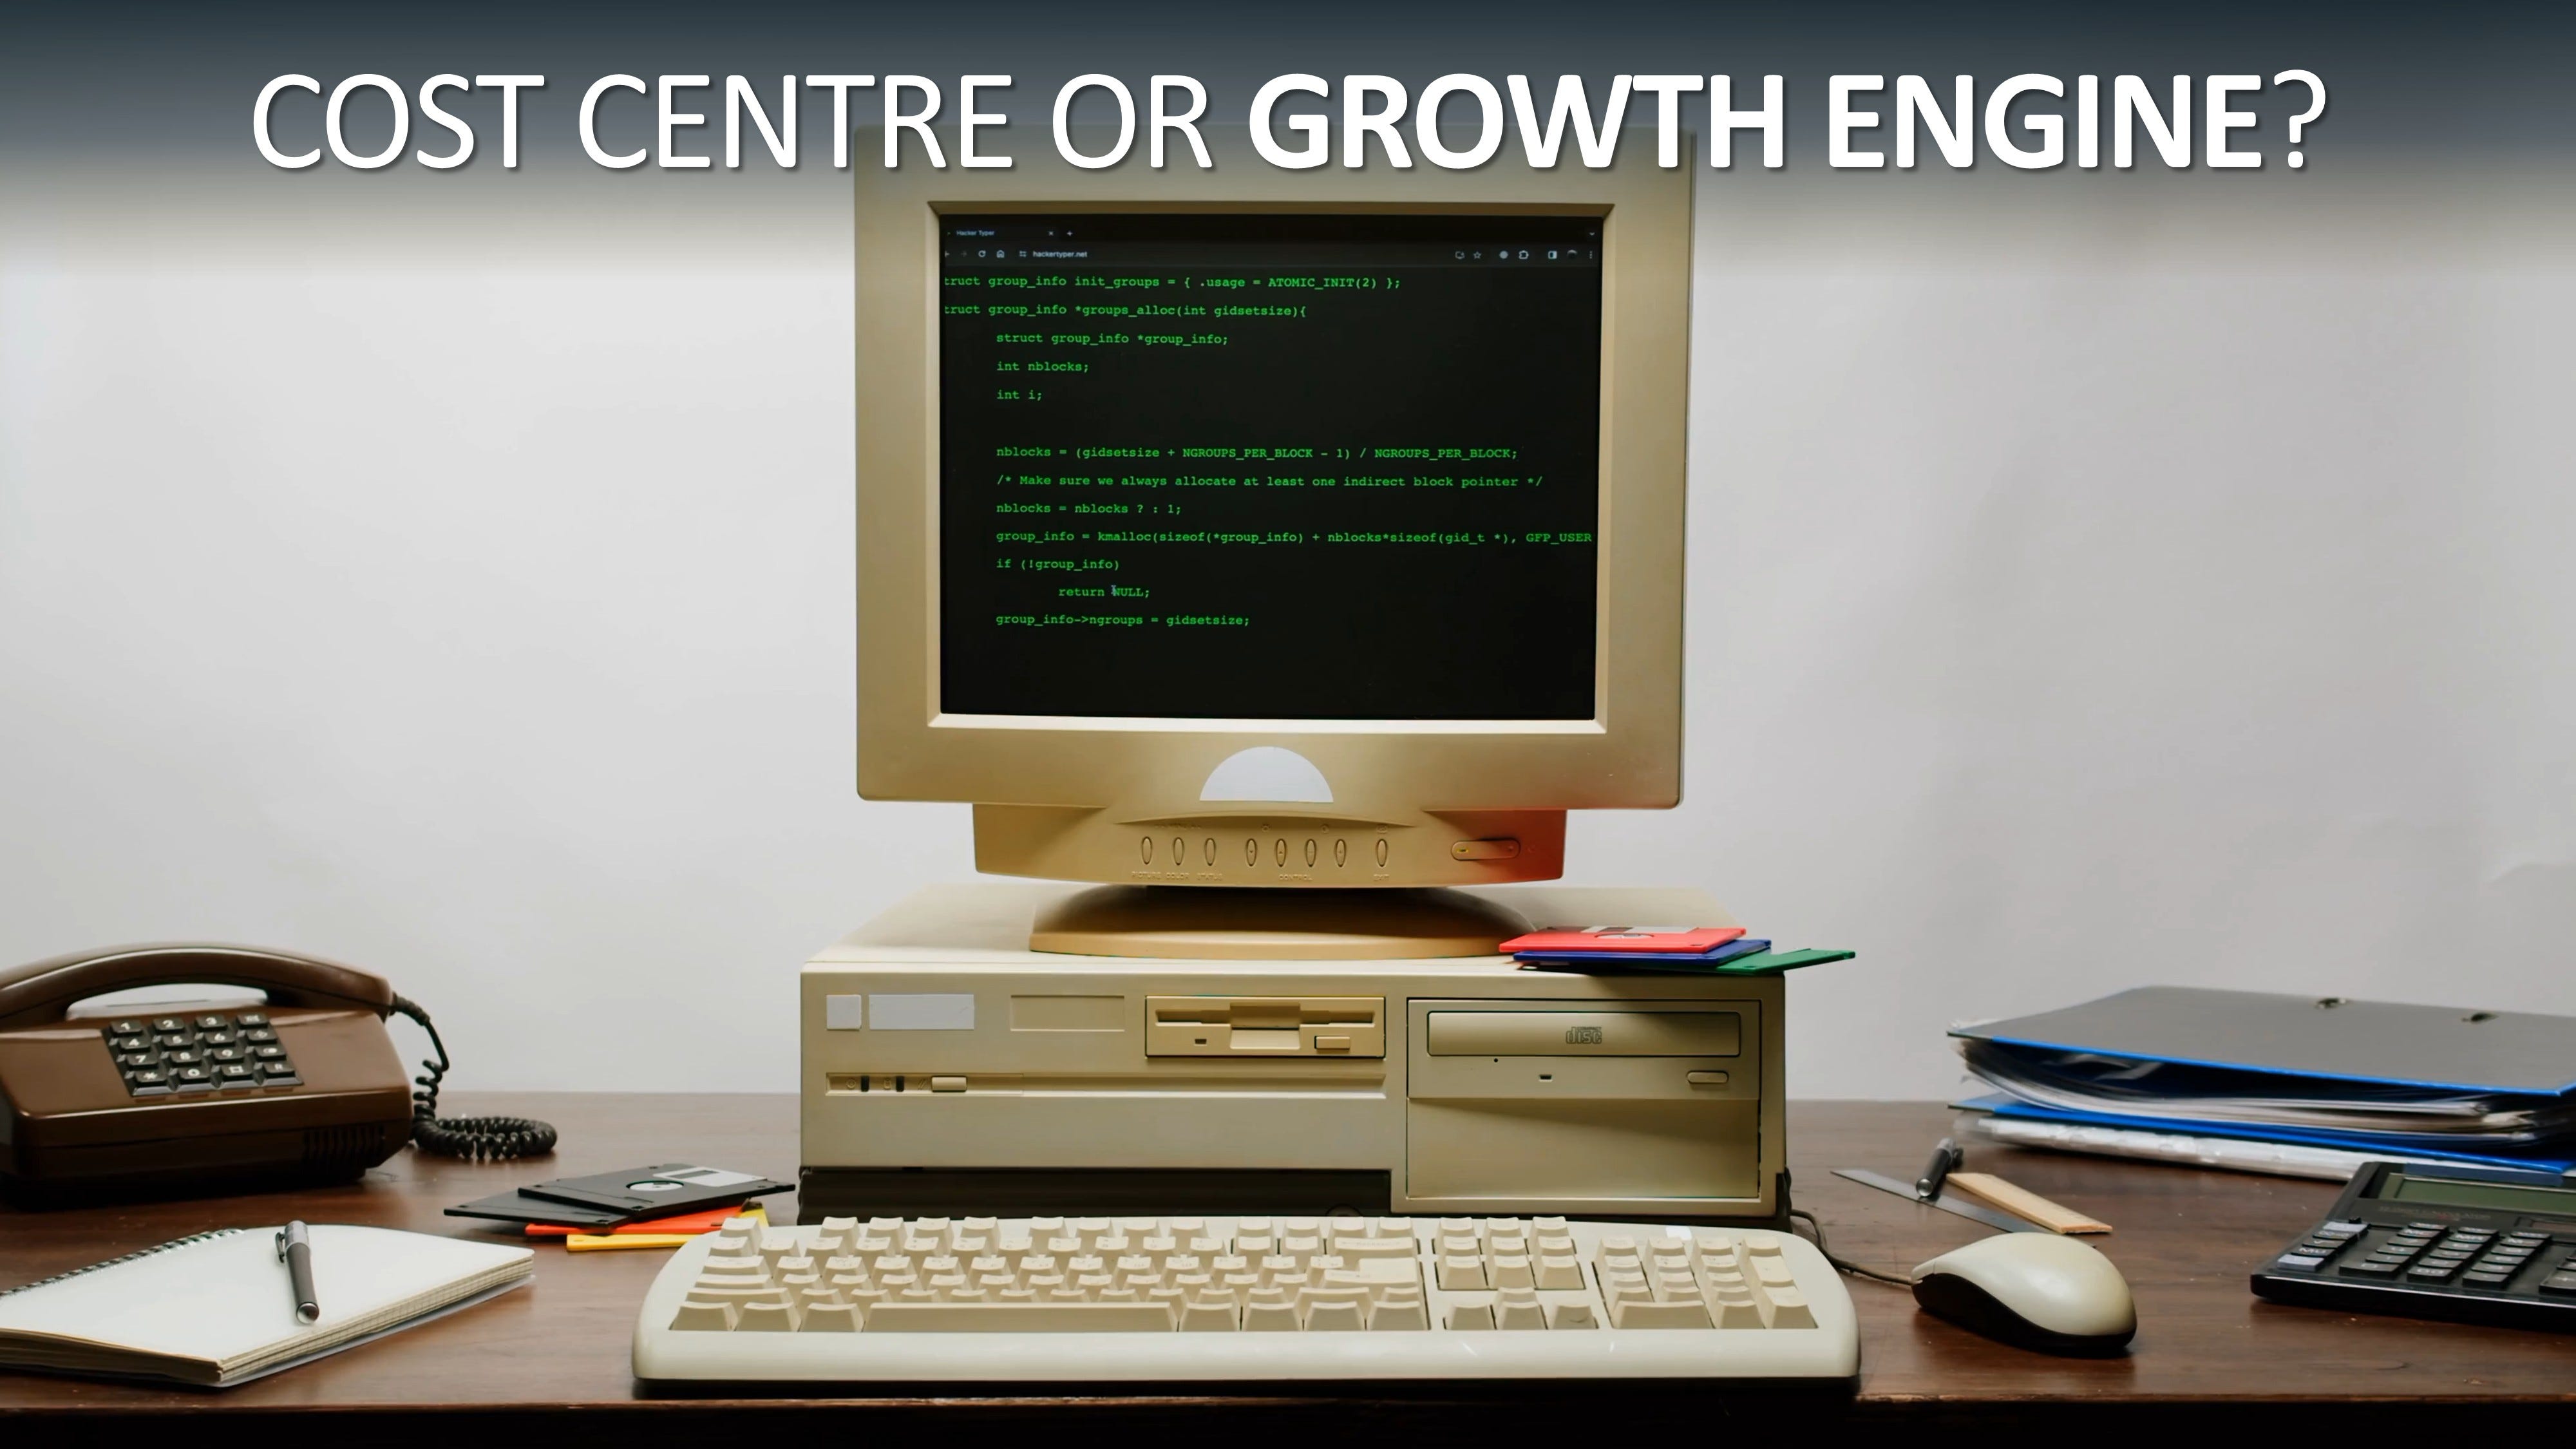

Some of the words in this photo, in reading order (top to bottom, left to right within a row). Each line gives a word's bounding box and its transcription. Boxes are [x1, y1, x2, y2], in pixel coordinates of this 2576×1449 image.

[1032, 251, 1088, 259] hackertyper.net
[987, 274, 1068, 290] group_info
[1074, 275, 1162, 290] init_groups
[1200, 278, 1247, 290] .usage
[1267, 276, 1378, 292] ATOMIC_INIT(2)
[1386, 277, 1401, 290] };
[987, 303, 1069, 317] group_info
[1213, 304, 1307, 319] gidsetsize){
[996, 332, 1045, 343] struct
[1050, 332, 1131, 346] group_info
[997, 360, 1021, 372] int
[1027, 360, 1090, 374] nblocks;
[997, 388, 1021, 400] int
[1028, 388, 1042, 401] i;
[996, 445, 1052, 458] nblocks
[1075, 446, 1162, 460] (gidsetsize
[1168, 448, 1177, 457] +
[1182, 446, 1314, 462] NGROUPS_PER_BLOCK
[1337, 447, 1351, 460] 1)
[1374, 447, 1518, 462] NGROUPS_PER_BLOCK;
[1019, 474, 1053, 486] Make
[1059, 476, 1092, 486] sure
[1097, 477, 1115, 486] we
[1121, 475, 1169, 489] always
[1174, 475, 1238, 487] allocate
[1243, 475, 1259, 487] at
[1267, 475, 1306, 487] least
[1312, 477, 1338, 488] one
[1343, 475, 1406, 488] indirect
[1413, 475, 1455, 488] block
[1460, 476, 1519, 489] pointer
[996, 502, 1052, 514] nblocks
[1074, 502, 1130, 514] nblocks
[1137, 503, 1144, 514] ?
[1168, 503, 1182, 516] 1;
[996, 529, 1076, 544] group_info
[1312, 533, 1321, 541] +
[1525, 531, 1593, 545] GFP_USER
[996, 557, 1013, 569] if
[1020, 557, 1121, 573] (!group_info)
[1057, 587, 1106, 598] return
[996, 613, 1144, 628] group_info->ngroups
[1165, 614, 1251, 628] gidsetsize;
[120, 1022, 130, 1030] 1
[163, 1019, 175, 1028] 2
[205, 1017, 217, 1026] 3
[128, 1038, 140, 1046] 4
[214, 1033, 225, 1041] 6
[135, 1054, 146, 1063] 7
[222, 1049, 233, 1057] 9
[187, 1068, 200, 1077] 0
